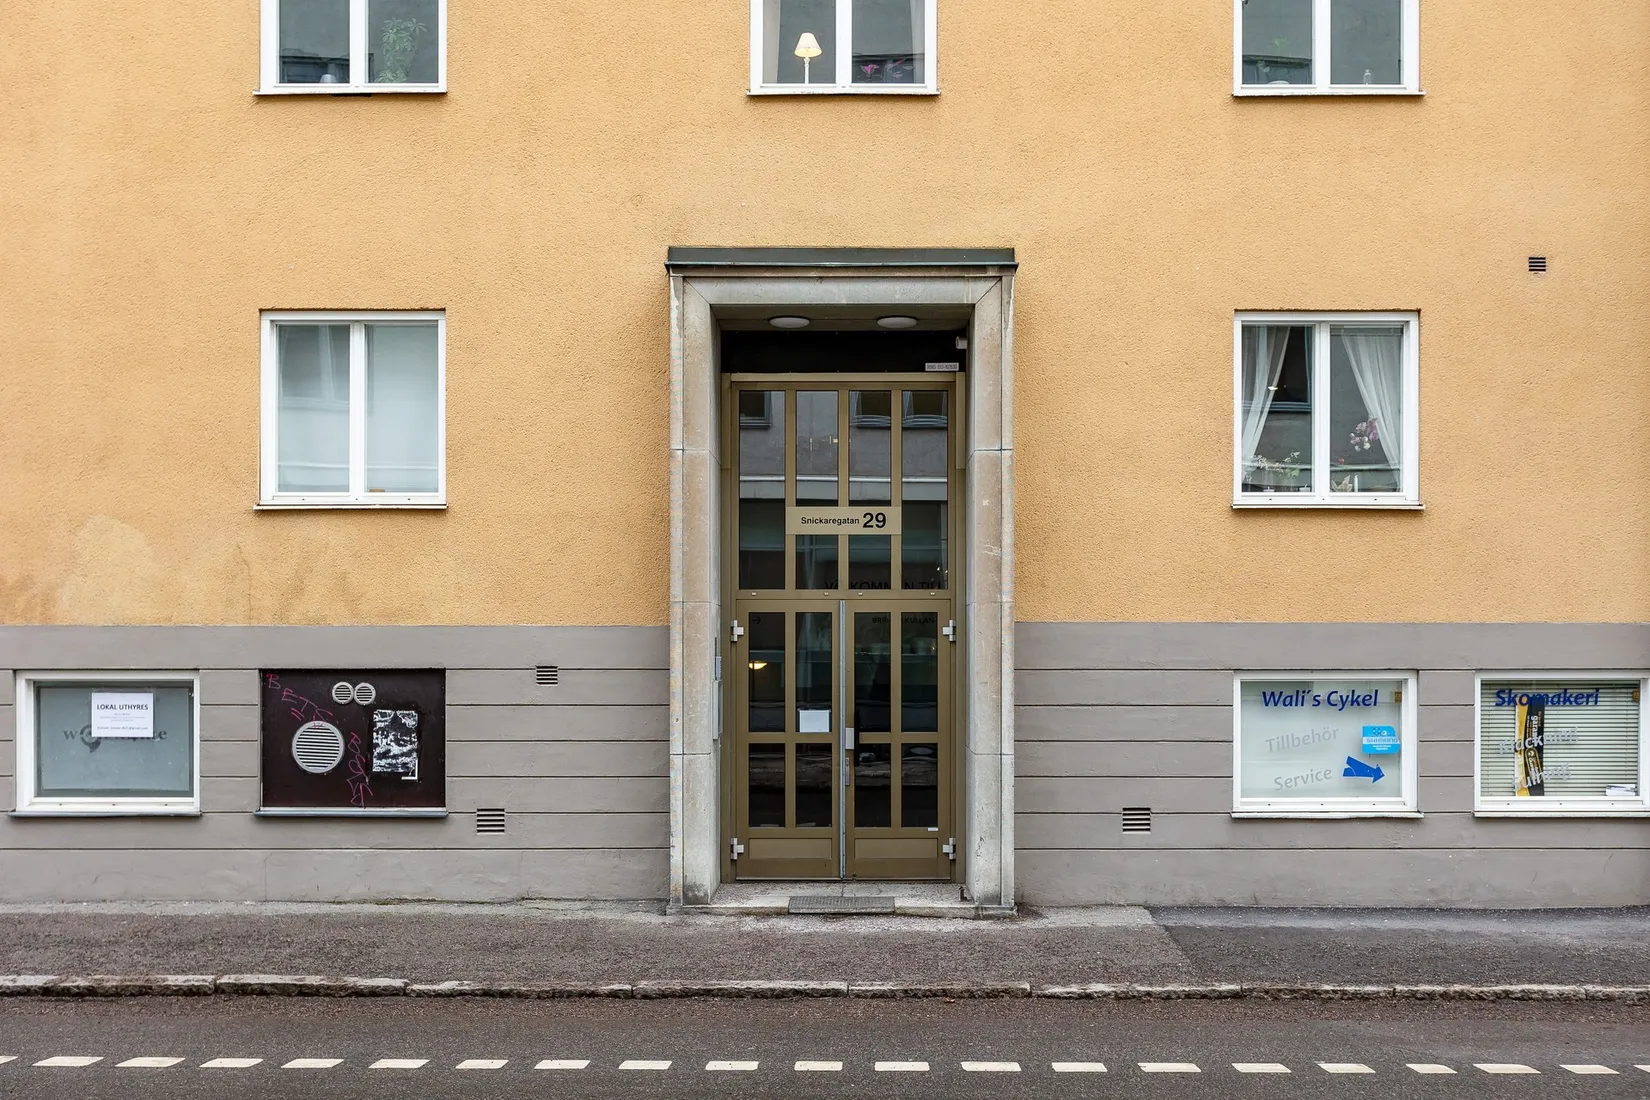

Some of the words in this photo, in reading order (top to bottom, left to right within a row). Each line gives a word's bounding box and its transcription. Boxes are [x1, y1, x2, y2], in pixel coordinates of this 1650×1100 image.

[801, 517, 860, 526] Snickaregatan
[862, 512, 886, 528] 29
[1326, 689, 1379, 711] Cykel
[1495, 688, 1599, 707] Skomakeri
[1265, 726, 1339, 753] Tillbehör
[1274, 768, 1333, 791] Service
